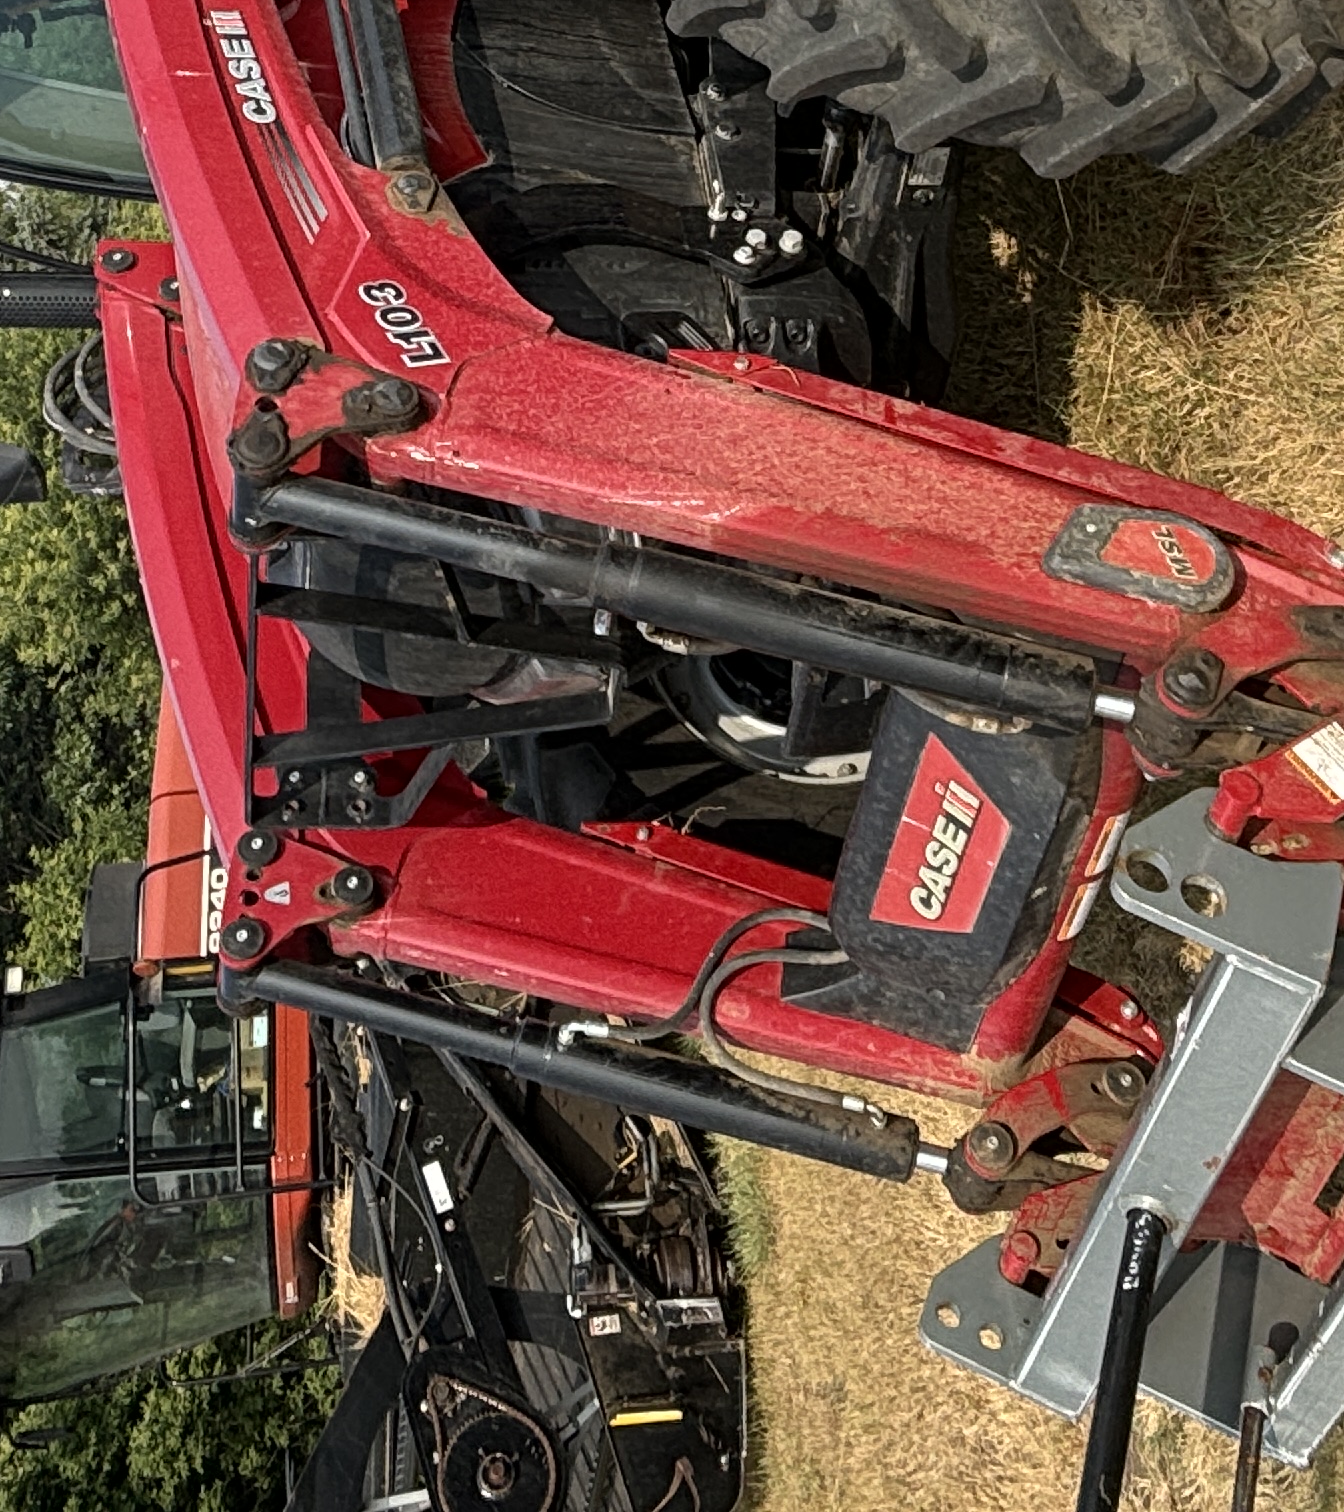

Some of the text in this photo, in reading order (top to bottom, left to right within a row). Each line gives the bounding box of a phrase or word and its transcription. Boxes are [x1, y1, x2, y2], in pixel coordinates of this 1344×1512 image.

[219, 38, 277, 124] CASE
[358, 279, 452, 368] L103
[1151, 524, 1199, 579] MSL
[909, 814, 968, 921] CASE
